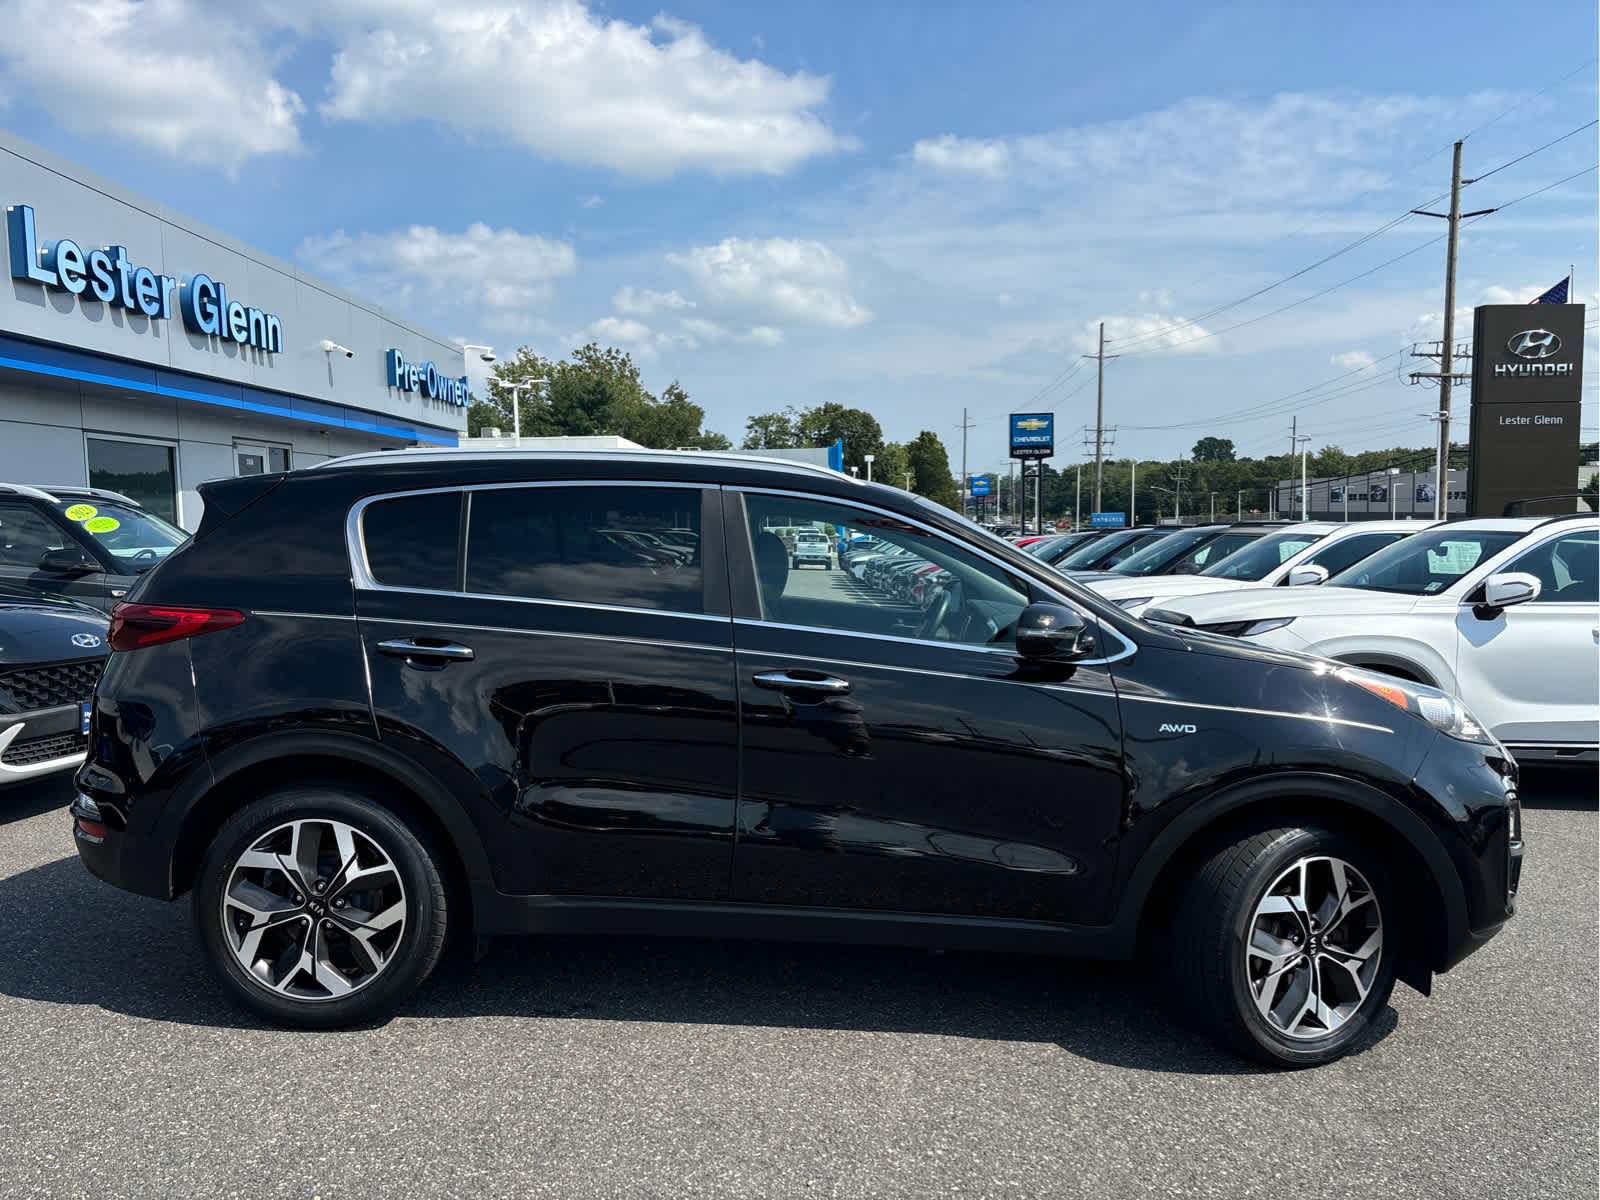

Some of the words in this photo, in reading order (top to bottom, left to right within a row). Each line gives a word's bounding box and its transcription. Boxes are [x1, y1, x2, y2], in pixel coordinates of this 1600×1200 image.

[10, 204, 177, 320] Lester
[183, 273, 283, 353] Glenn
[1494, 363, 1574, 374] HYUNDAI
[387, 348, 469, 408] Pre-Owned
[1499, 416, 1530, 425] Lester
[1534, 415, 1564, 425] Glenn
[1159, 723, 1197, 733] AWD
